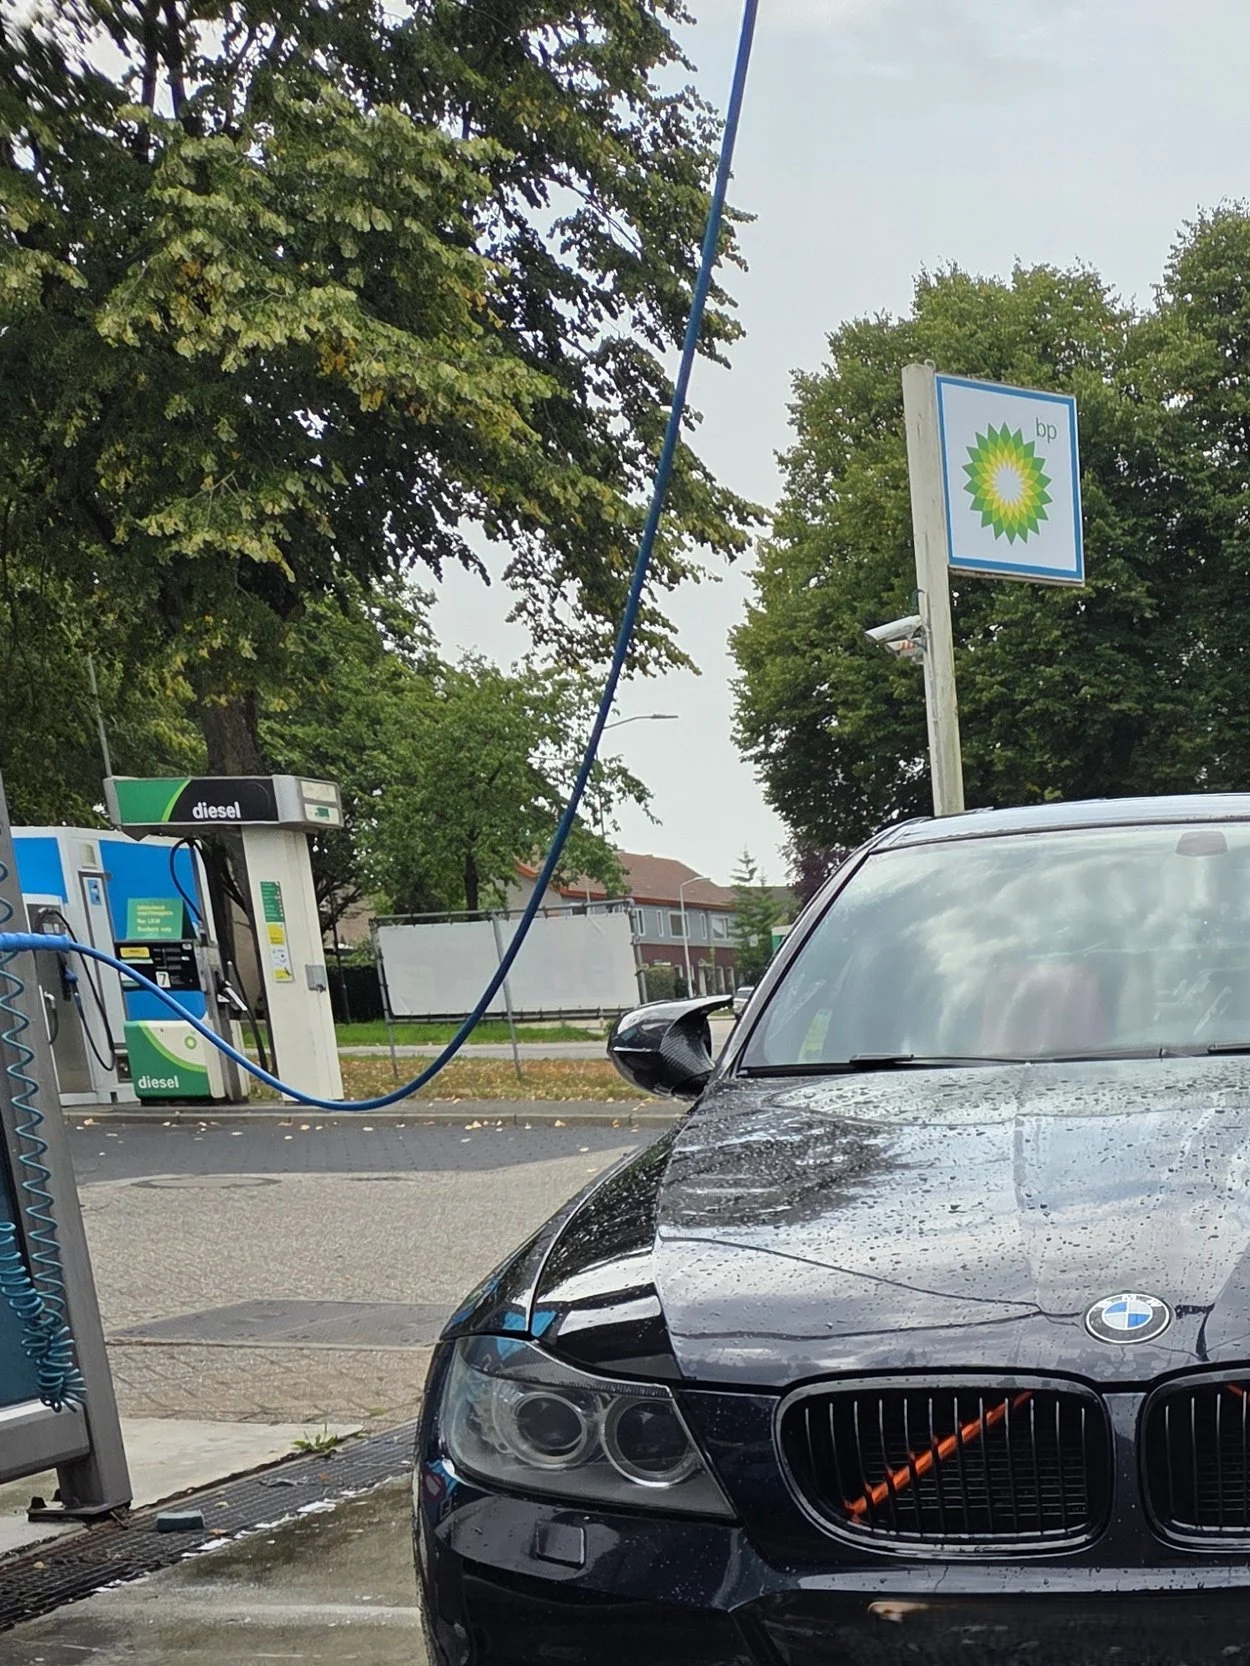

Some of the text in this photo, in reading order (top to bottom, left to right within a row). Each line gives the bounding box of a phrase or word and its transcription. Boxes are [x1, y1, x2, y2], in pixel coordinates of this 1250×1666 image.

[1036, 416, 1057, 444] bp
[192, 801, 242, 819] diesel
[158, 973, 167, 986] 7
[138, 1075, 180, 1089] diesel
